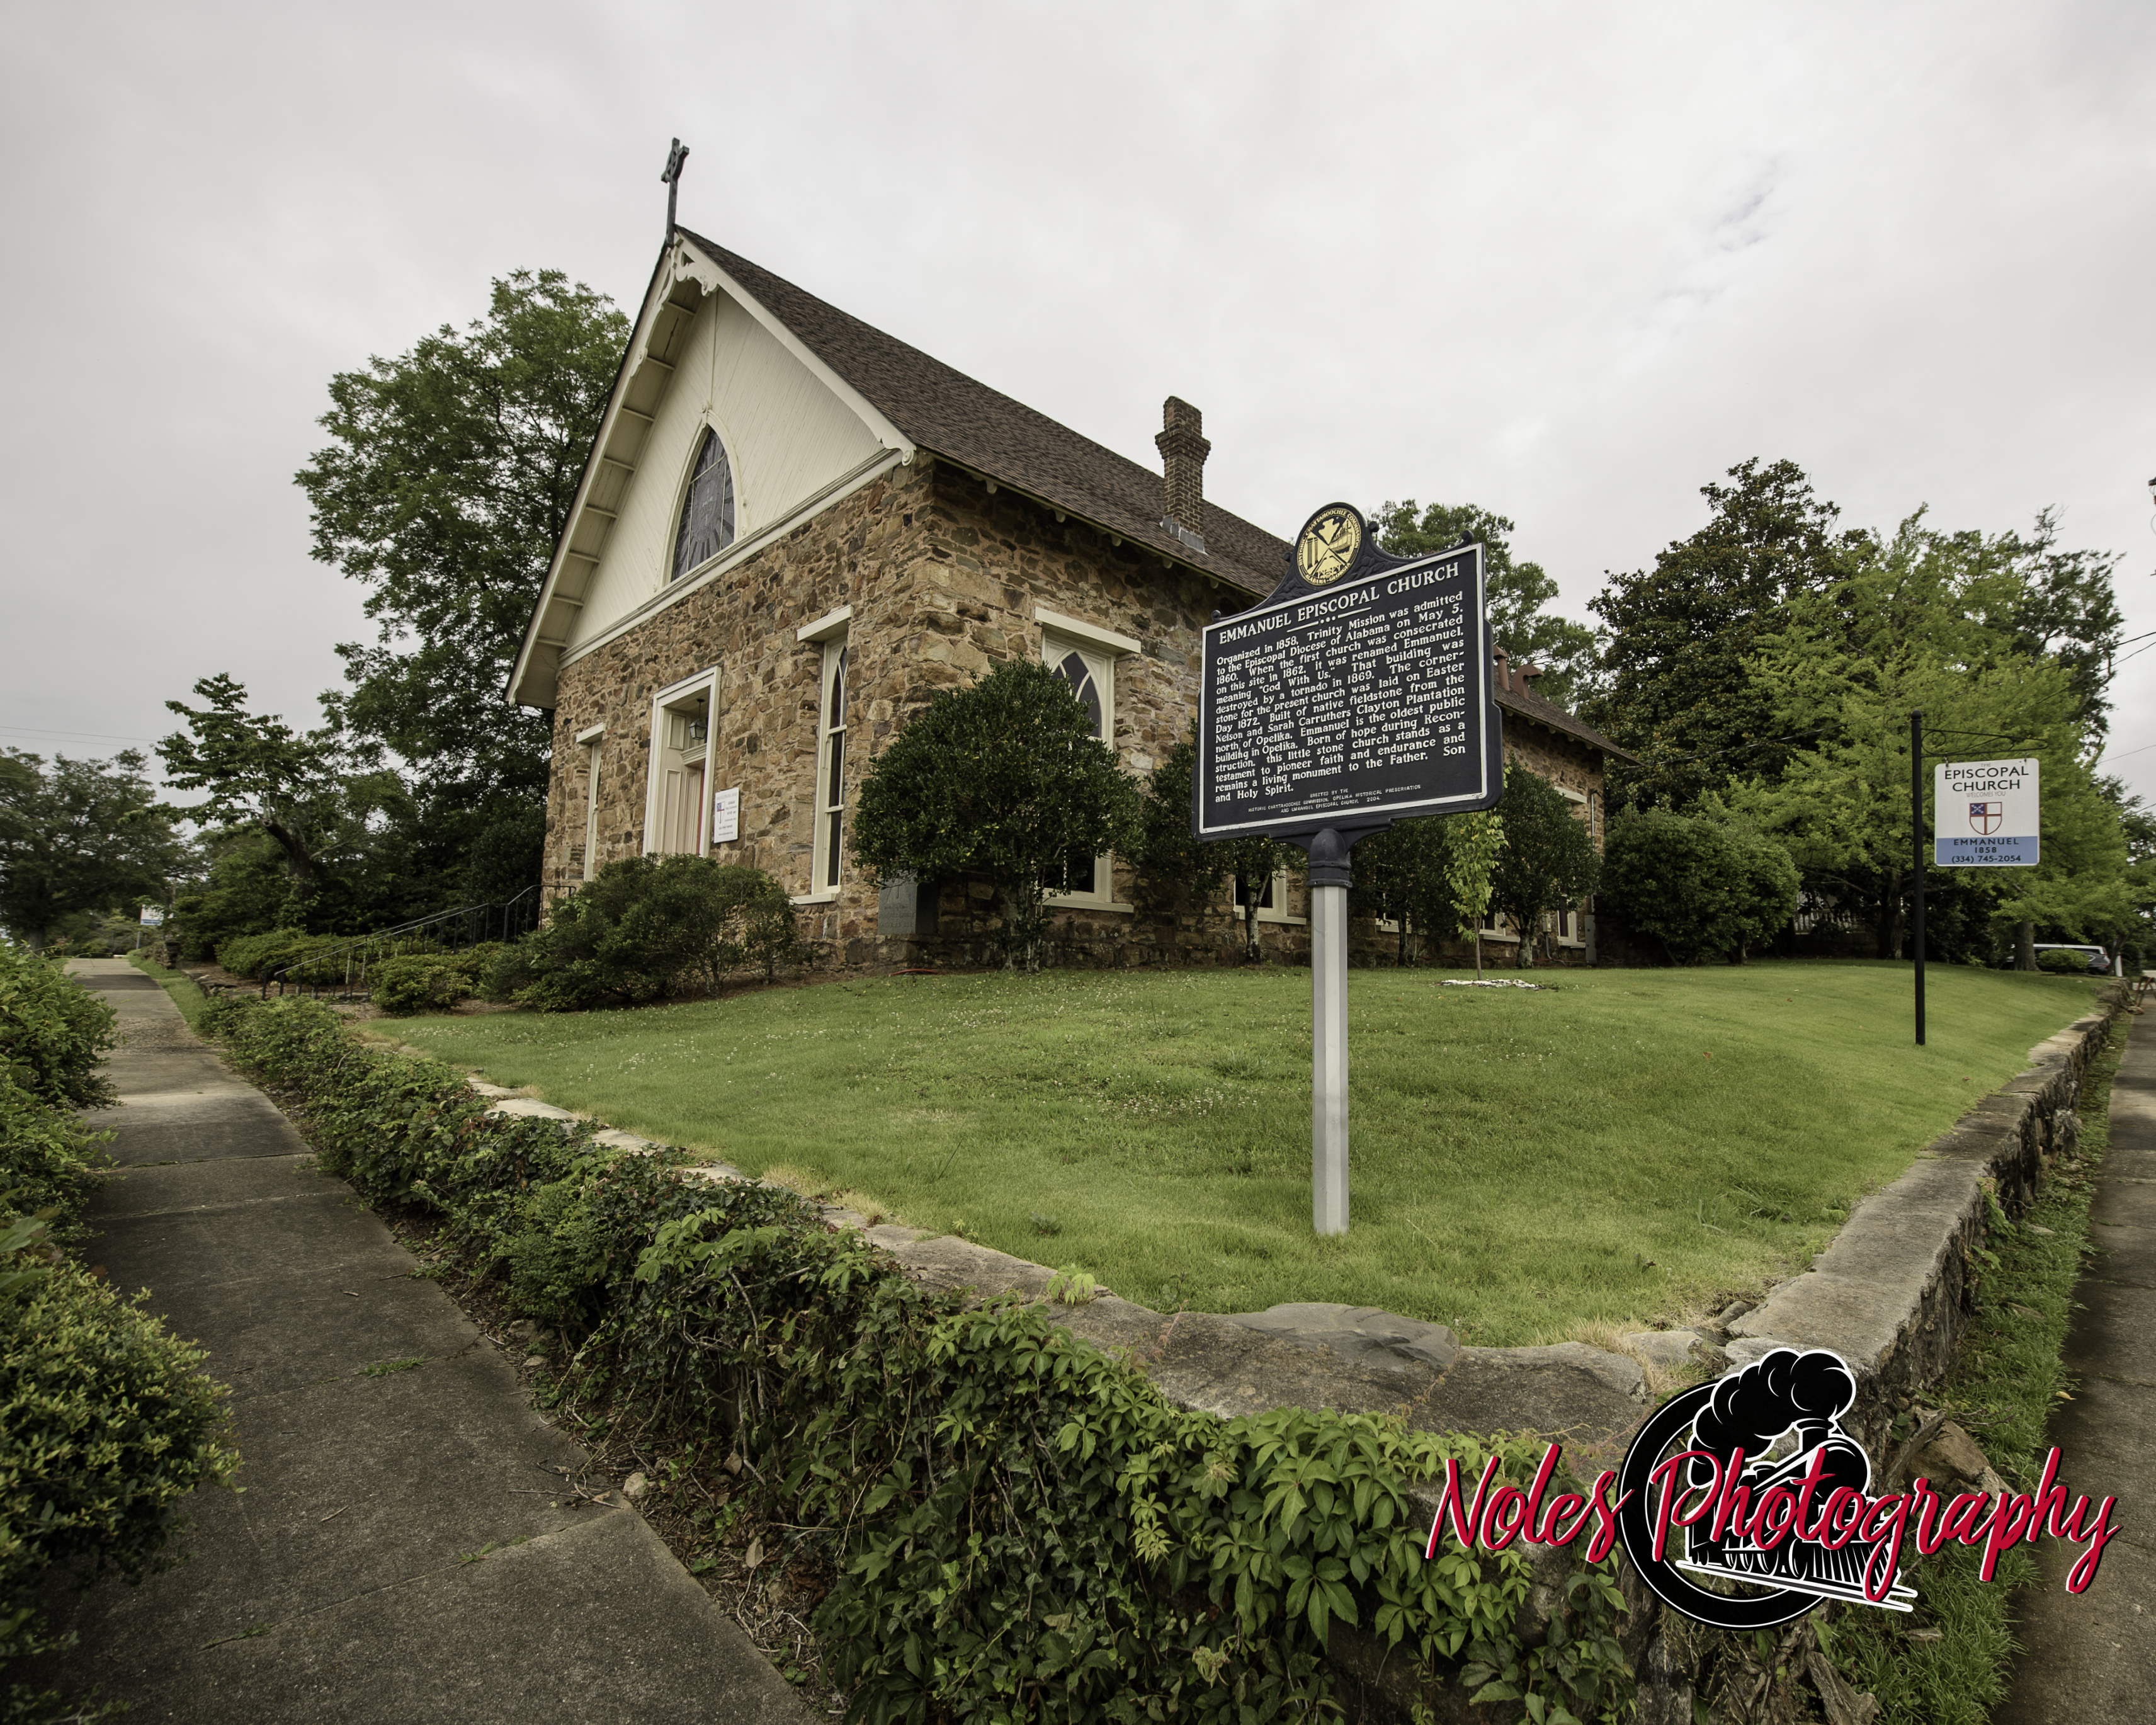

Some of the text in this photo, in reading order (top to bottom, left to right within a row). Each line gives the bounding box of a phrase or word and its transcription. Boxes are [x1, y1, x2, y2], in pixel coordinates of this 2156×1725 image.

[1217, 646, 1261, 666] Organized
[1264, 644, 1273, 654] in
[1307, 625, 1343, 641] Trinity
[1348, 614, 1385, 630] Mission
[1388, 608, 1409, 619] was
[1414, 590, 1463, 613] admitted
[1219, 562, 1459, 644] EMMANUEL EPISCOPAL CHURCH
[1216, 686, 1227, 695] on
[1230, 681, 1245, 692] this
[1249, 676, 1265, 687] site
[1269, 673, 1278, 682] in
[1315, 661, 1322, 671] it
[1327, 656, 1347, 667] was
[1352, 642, 1397, 661] renamed
[1217, 667, 1226, 676] to
[1228, 663, 1242, 673] the
[1245, 649, 1286, 669] Episcopal
[1290, 640, 1326, 657] Diocese
[1330, 634, 1341, 646] of
[1345, 624, 1390, 642] Alabama
[1397, 618, 1410, 628] on
[1419, 610, 1443, 623] May
[1249, 662, 1274, 677] When
[1279, 659, 1295, 669] the
[1299, 651, 1320, 664] first
[1325, 640, 1361, 657] church
[1367, 635, 1387, 646] was
[1393, 614, 1463, 640] consecrated
[1215, 697, 1259, 714] destroyed
[1263, 695, 1275, 705] by
[1291, 681, 1328, 697] tornado
[1332, 678, 1342, 688] in
[1389, 663, 1411, 675] The
[1419, 651, 1465, 668] corner-
[1215, 663, 1465, 724] stone for the present church was laid on Easter
[1216, 690, 1252, 705] meaning
[1288, 675, 1310, 687] With
[1351, 658, 1376, 672] That
[1386, 647, 1431, 666] building
[1442, 639, 1464, 651] was
[1215, 724, 1233, 736] Day
[1269, 710, 1291, 723] Built
[1296, 706, 1307, 717] of
[1313, 700, 1344, 713] native
[1349, 688, 1402, 705] fieldstone
[1410, 681, 1438, 693] from
[1445, 675, 1465, 686] the
[1215, 686, 1465, 744] Nelson and Sarah Carruthers Clayton Plantation
[1215, 740, 1239, 753] north
[1242, 737, 1252, 748] of
[1300, 719, 1349, 737] Emmanuel
[1356, 716, 1364, 726] is
[1368, 713, 1386, 724] the
[1390, 704, 1424, 719] oldest
[1429, 697, 1465, 714] public
[1215, 749, 1249, 763] building
[1251, 747, 1260, 757] in
[1307, 735, 1331, 746] Born
[1336, 729, 1347, 741] of
[1351, 726, 1377, 739] hope
[1381, 719, 1417, 735] during
[1424, 710, 1465, 725] Recon-
[1215, 731, 1465, 783] testament to pioneer faith and endurance and
[1266, 753, 1283, 763] this
[1288, 748, 1311, 760] little
[1317, 743, 1344, 755] stone
[1352, 734, 1389, 749] church
[1395, 727, 1430, 741] stands
[1438, 724, 1451, 733] as
[1458, 722, 1466, 730] a
[1215, 780, 1248, 793] remains
[1262, 773, 1288, 785] living
[1292, 765, 1342, 781] monument
[1348, 763, 1359, 771] to
[1365, 758, 1383, 769] the
[1443, 746, 1466, 756] Son
[1215, 783, 1294, 803] and Holy Spirit.
[1944, 766, 2029, 780] EPISCOPAL
[1953, 779, 2021, 792] CHURCH
[1951, 856, 1974, 864] (334)
[1954, 838, 2019, 846] EMMANUEL
